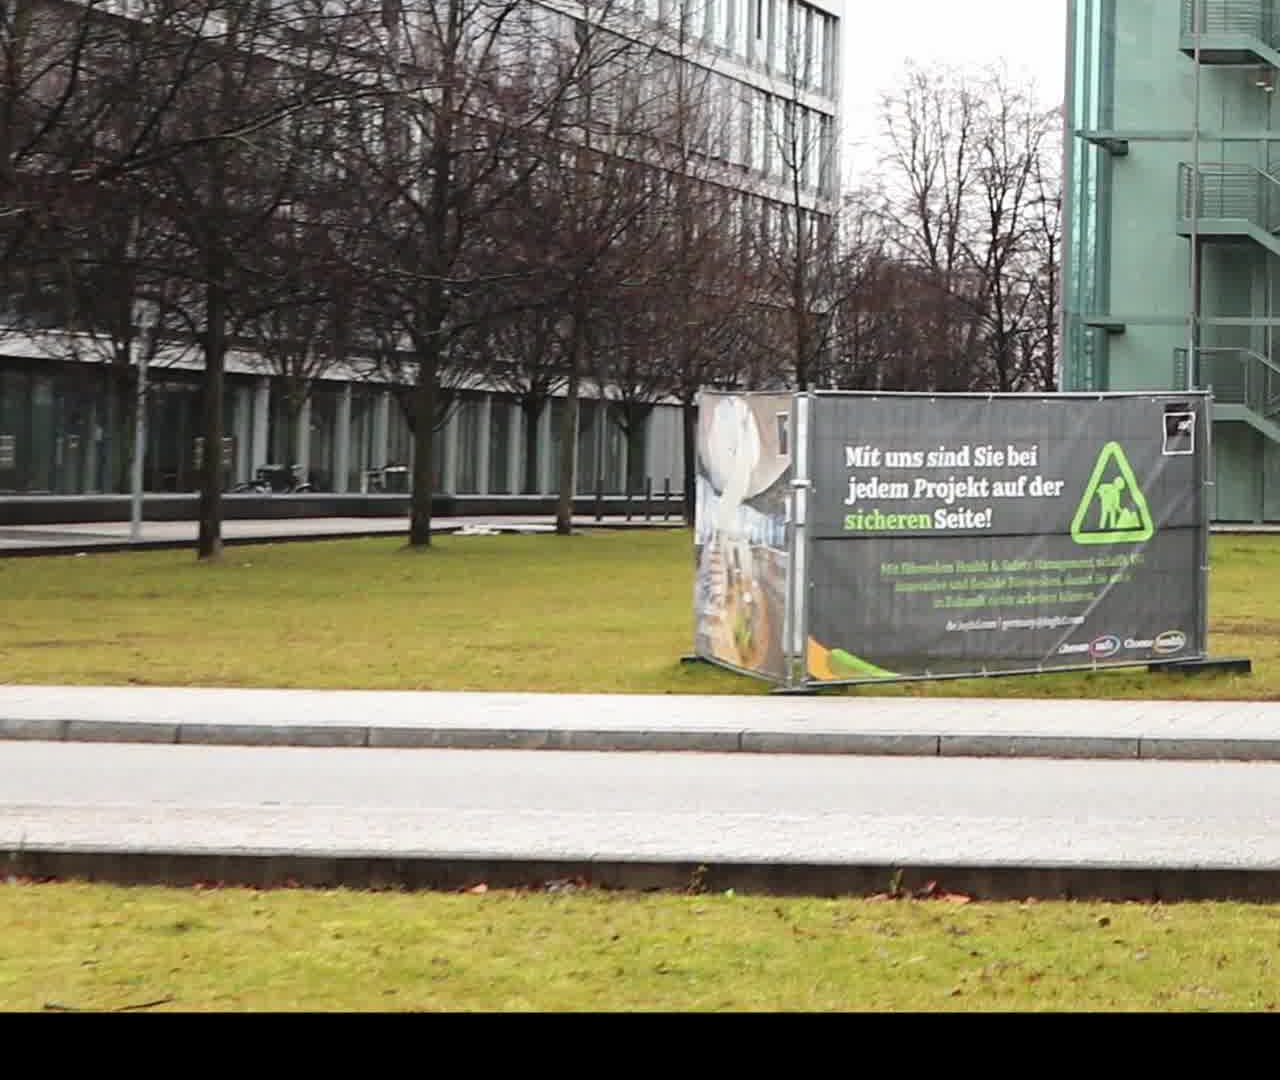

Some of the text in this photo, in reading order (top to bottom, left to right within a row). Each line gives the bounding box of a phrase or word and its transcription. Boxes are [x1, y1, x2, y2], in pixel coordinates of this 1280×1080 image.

[845, 445, 1038, 467] Mit uns sind Sie bei
[845, 476, 1065, 505] jedem Projekt auf der
[844, 508, 993, 529] sicheren Seite!
